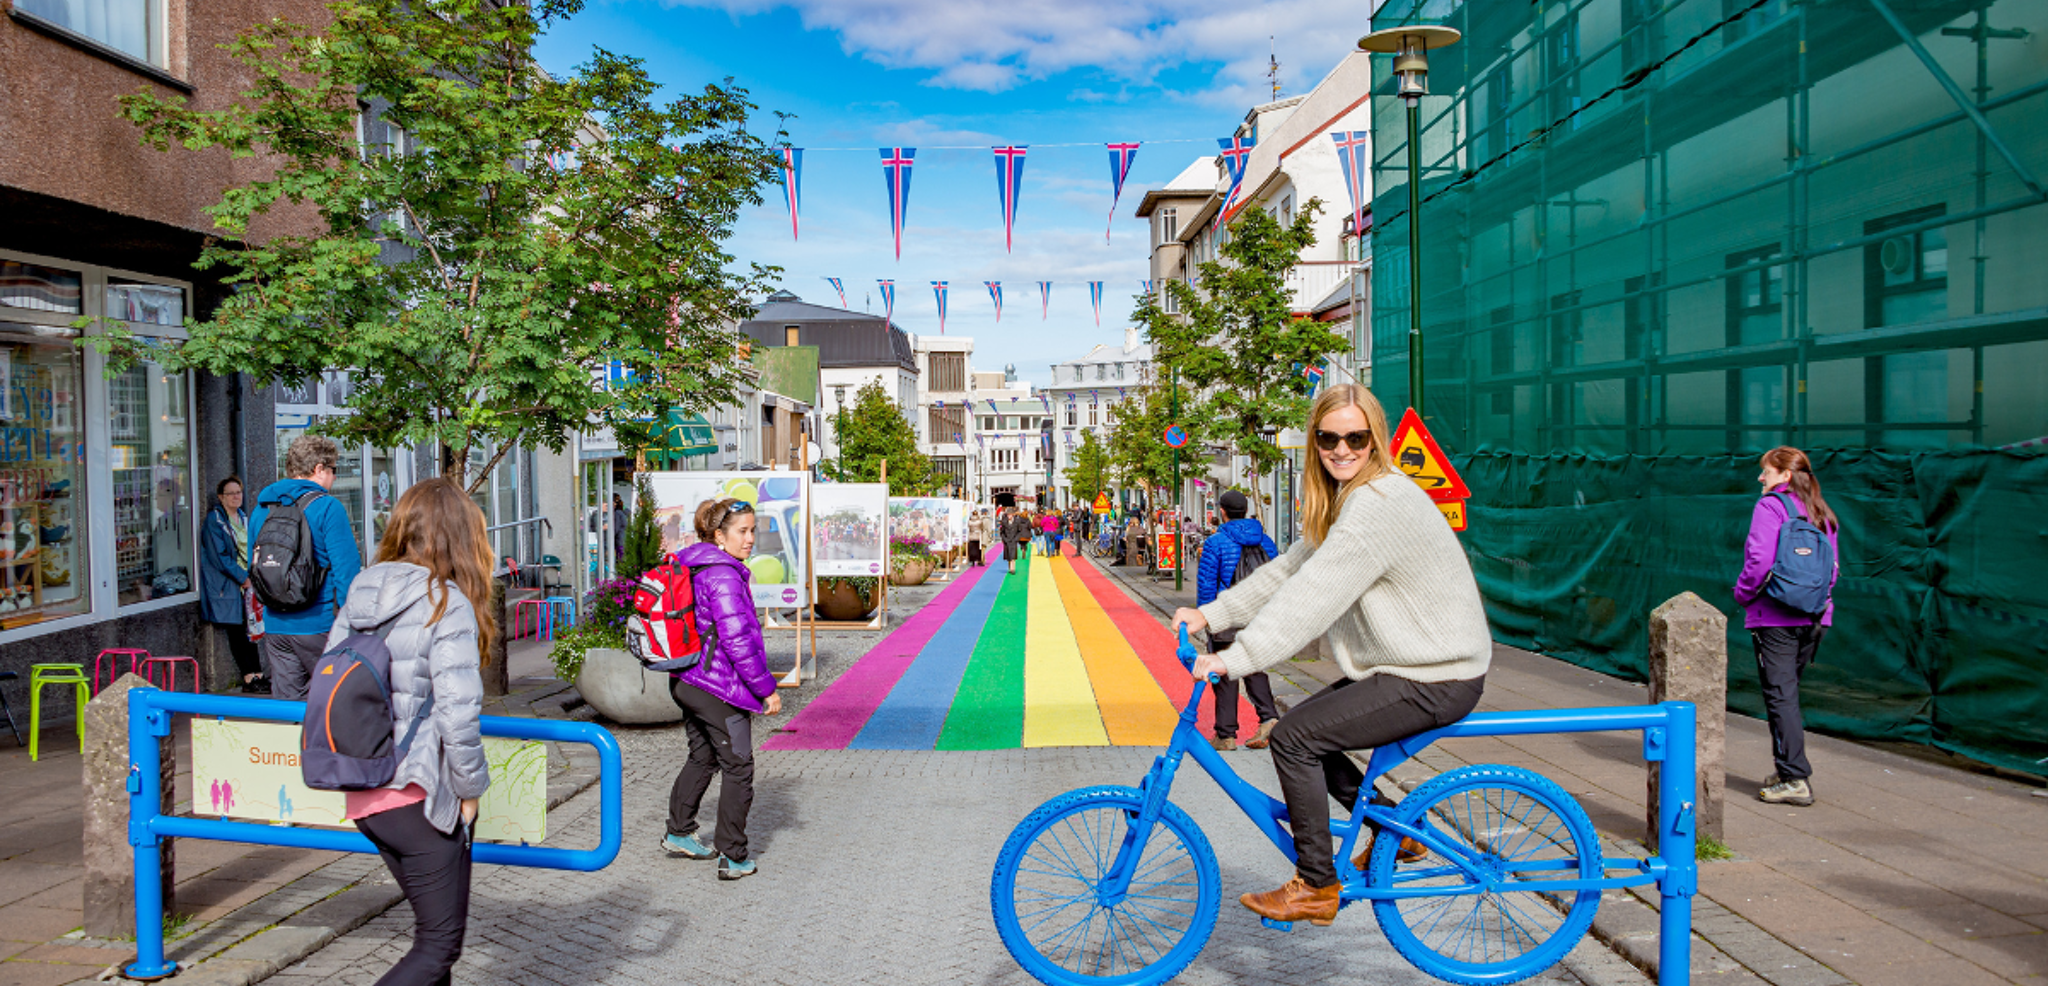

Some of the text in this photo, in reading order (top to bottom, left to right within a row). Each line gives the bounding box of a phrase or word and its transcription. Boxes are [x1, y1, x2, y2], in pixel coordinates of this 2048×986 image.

[0, 387, 54, 421] UY 3
[0, 428, 53, 462] ET 1
[0, 468, 55, 503] REE
[1443, 511, 1459, 520] KA
